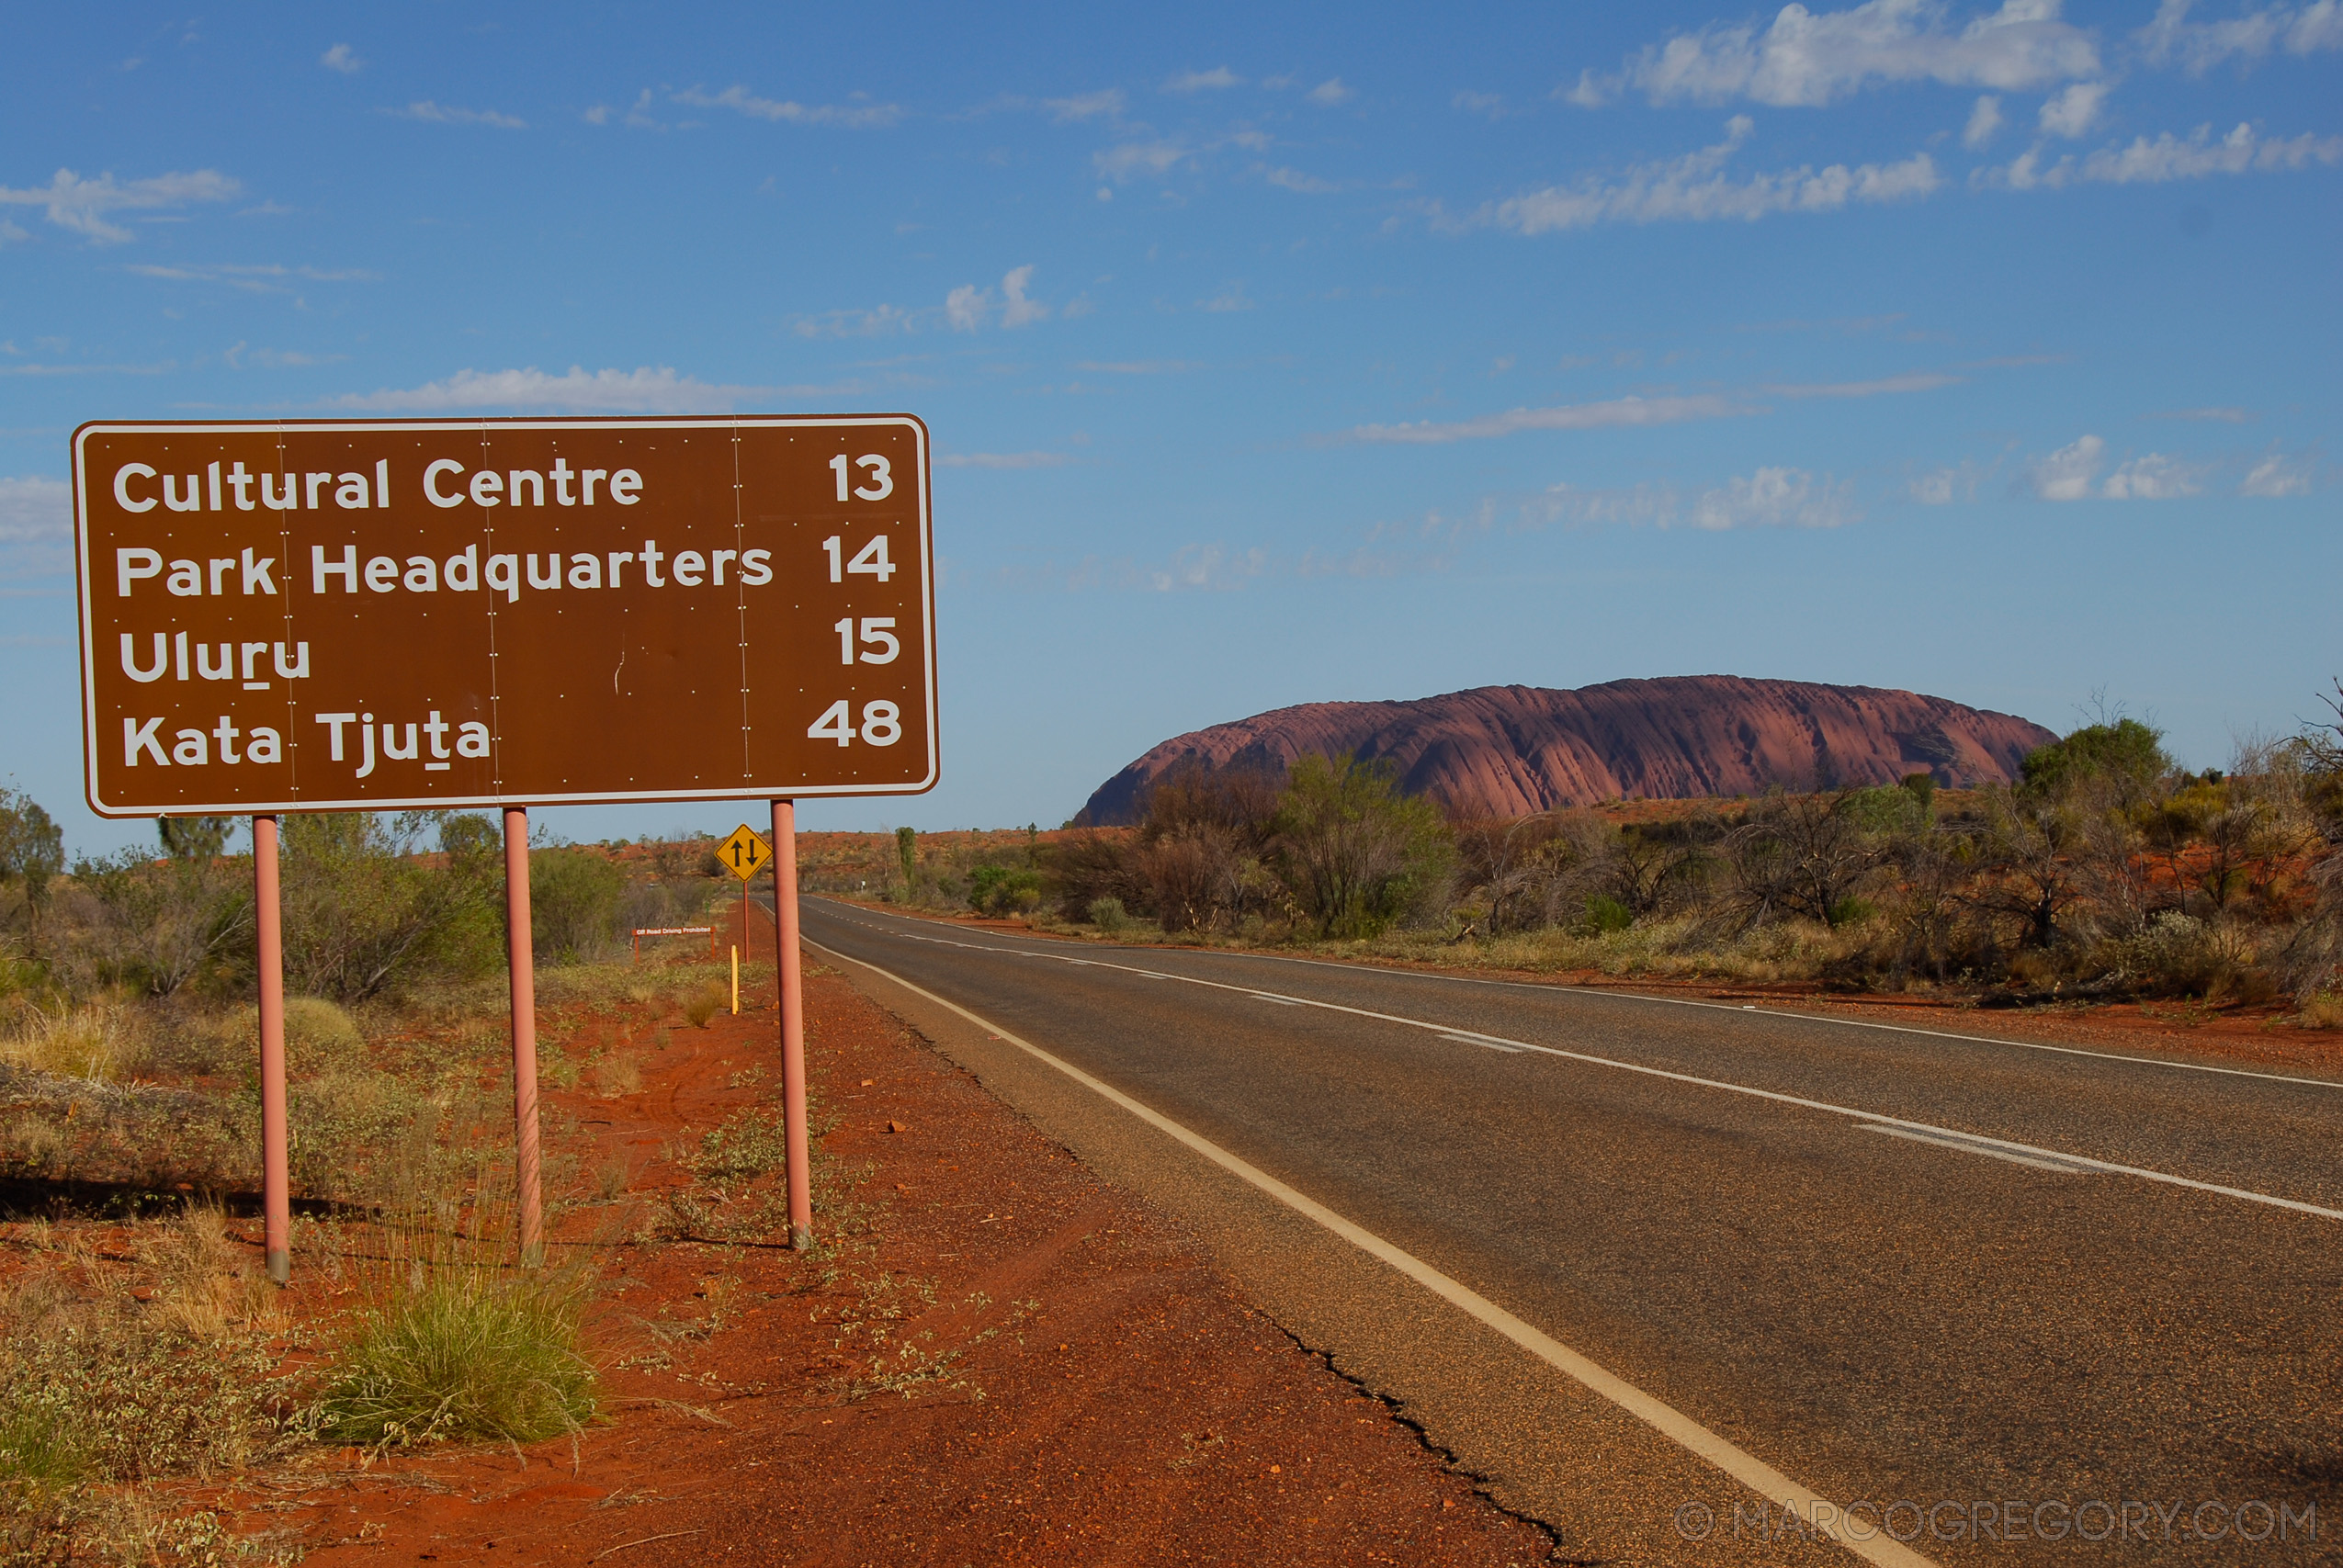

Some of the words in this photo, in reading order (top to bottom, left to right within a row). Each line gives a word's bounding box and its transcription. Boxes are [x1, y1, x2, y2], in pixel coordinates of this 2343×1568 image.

[113, 458, 390, 513] Cultural
[423, 457, 644, 510] Centre
[829, 454, 894, 502] 13
[117, 547, 278, 597] Park
[311, 539, 774, 604] Headquarters
[822, 535, 896, 583] 14
[834, 616, 900, 665] 15
[123, 716, 282, 767] Kata
[807, 699, 902, 747] 48
